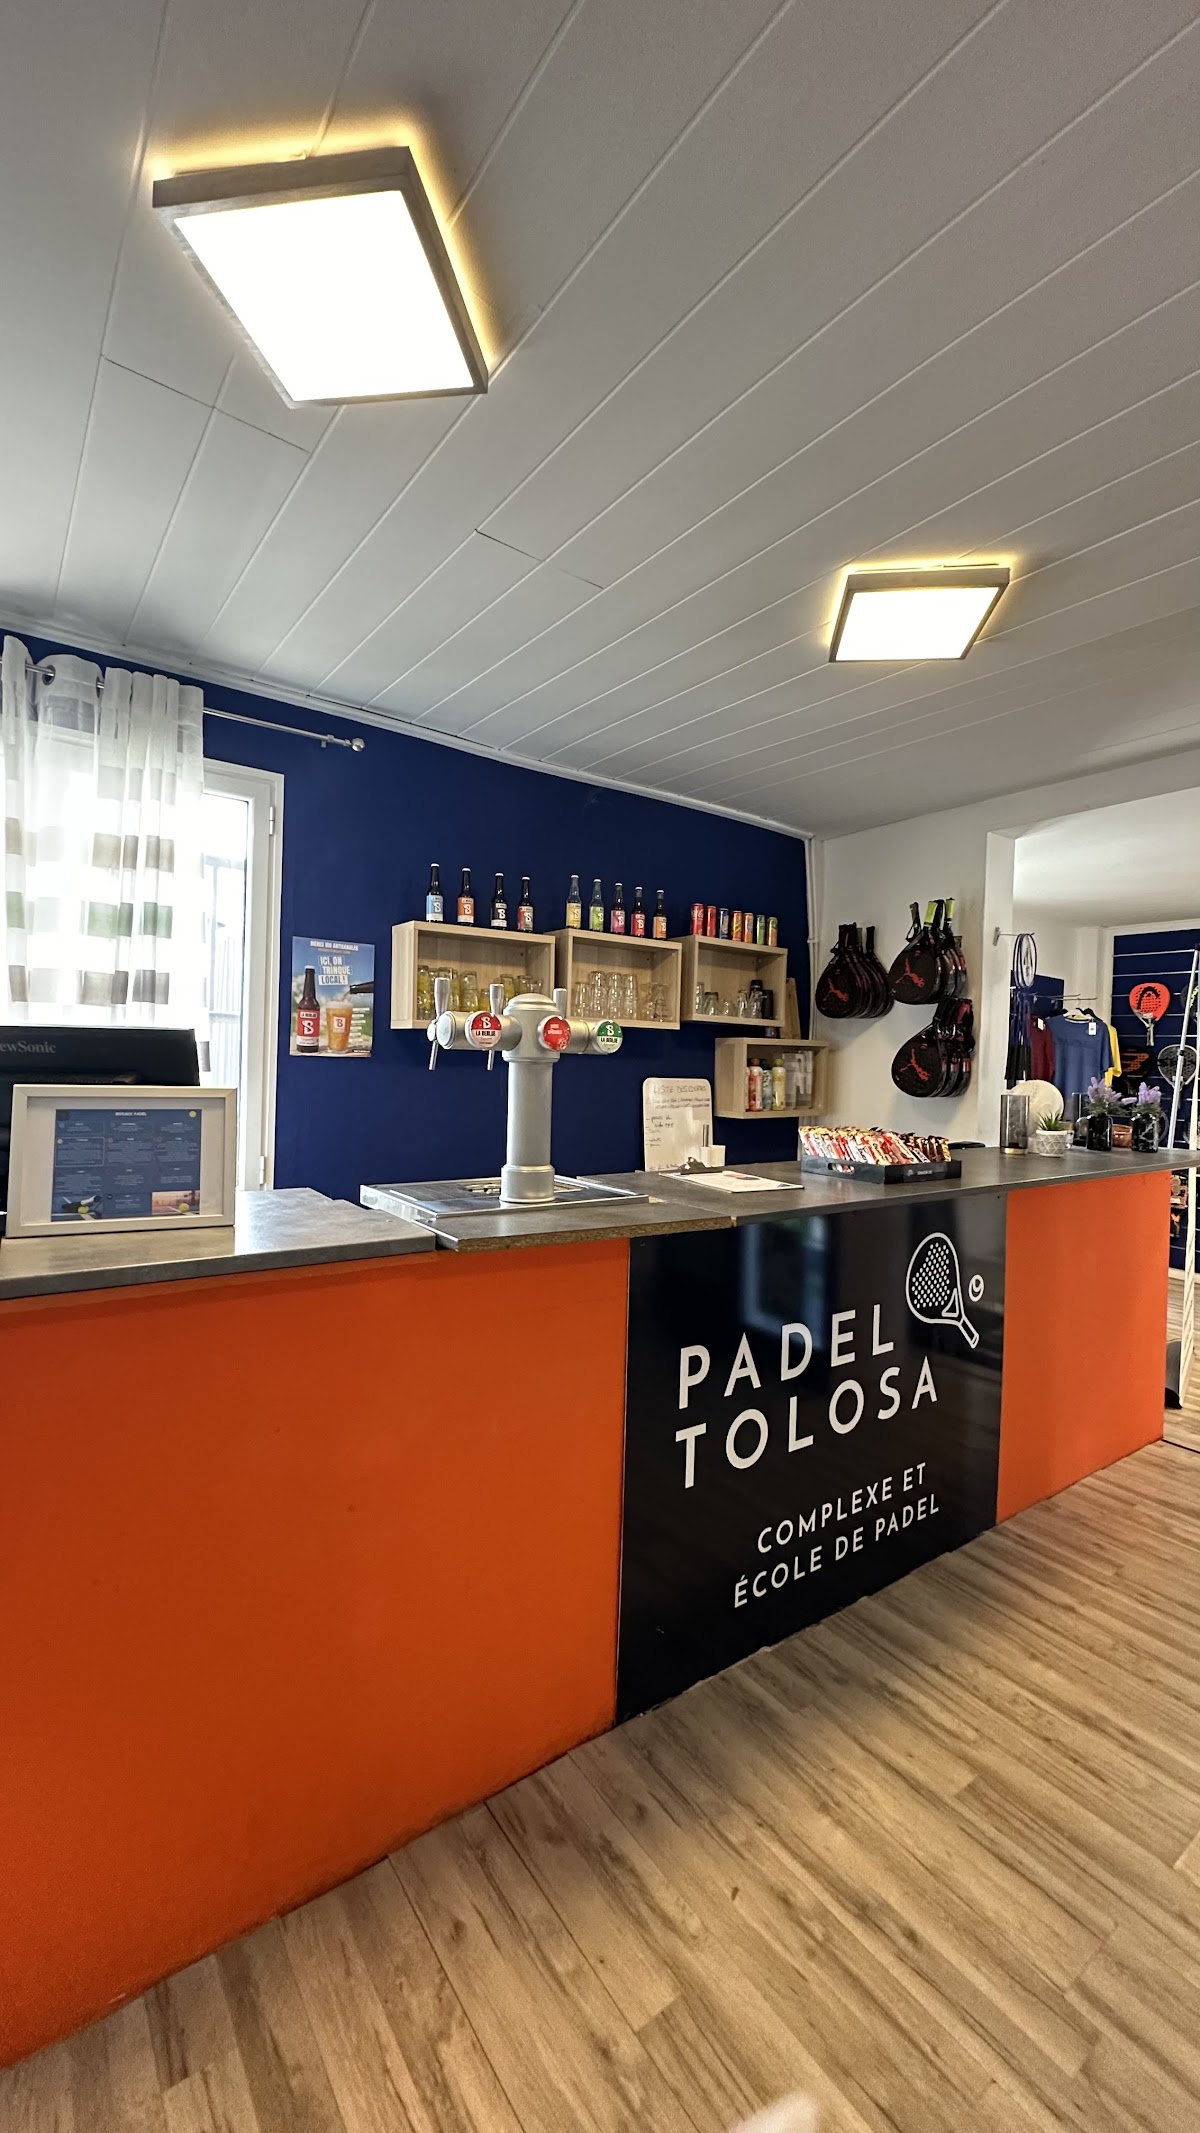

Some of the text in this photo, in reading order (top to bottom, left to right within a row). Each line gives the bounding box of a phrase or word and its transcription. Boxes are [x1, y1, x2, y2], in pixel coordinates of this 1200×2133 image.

[322, 965, 351, 975] TRINQUE
[332, 956, 342, 965] ON
[679, 1304, 894, 1410] PADEL
[675, 1355, 938, 1489] TOLOSA
[734, 1493, 940, 1608] ÉCOLE DE PADEL
[757, 1462, 926, 1554] COMPLEXE ET
